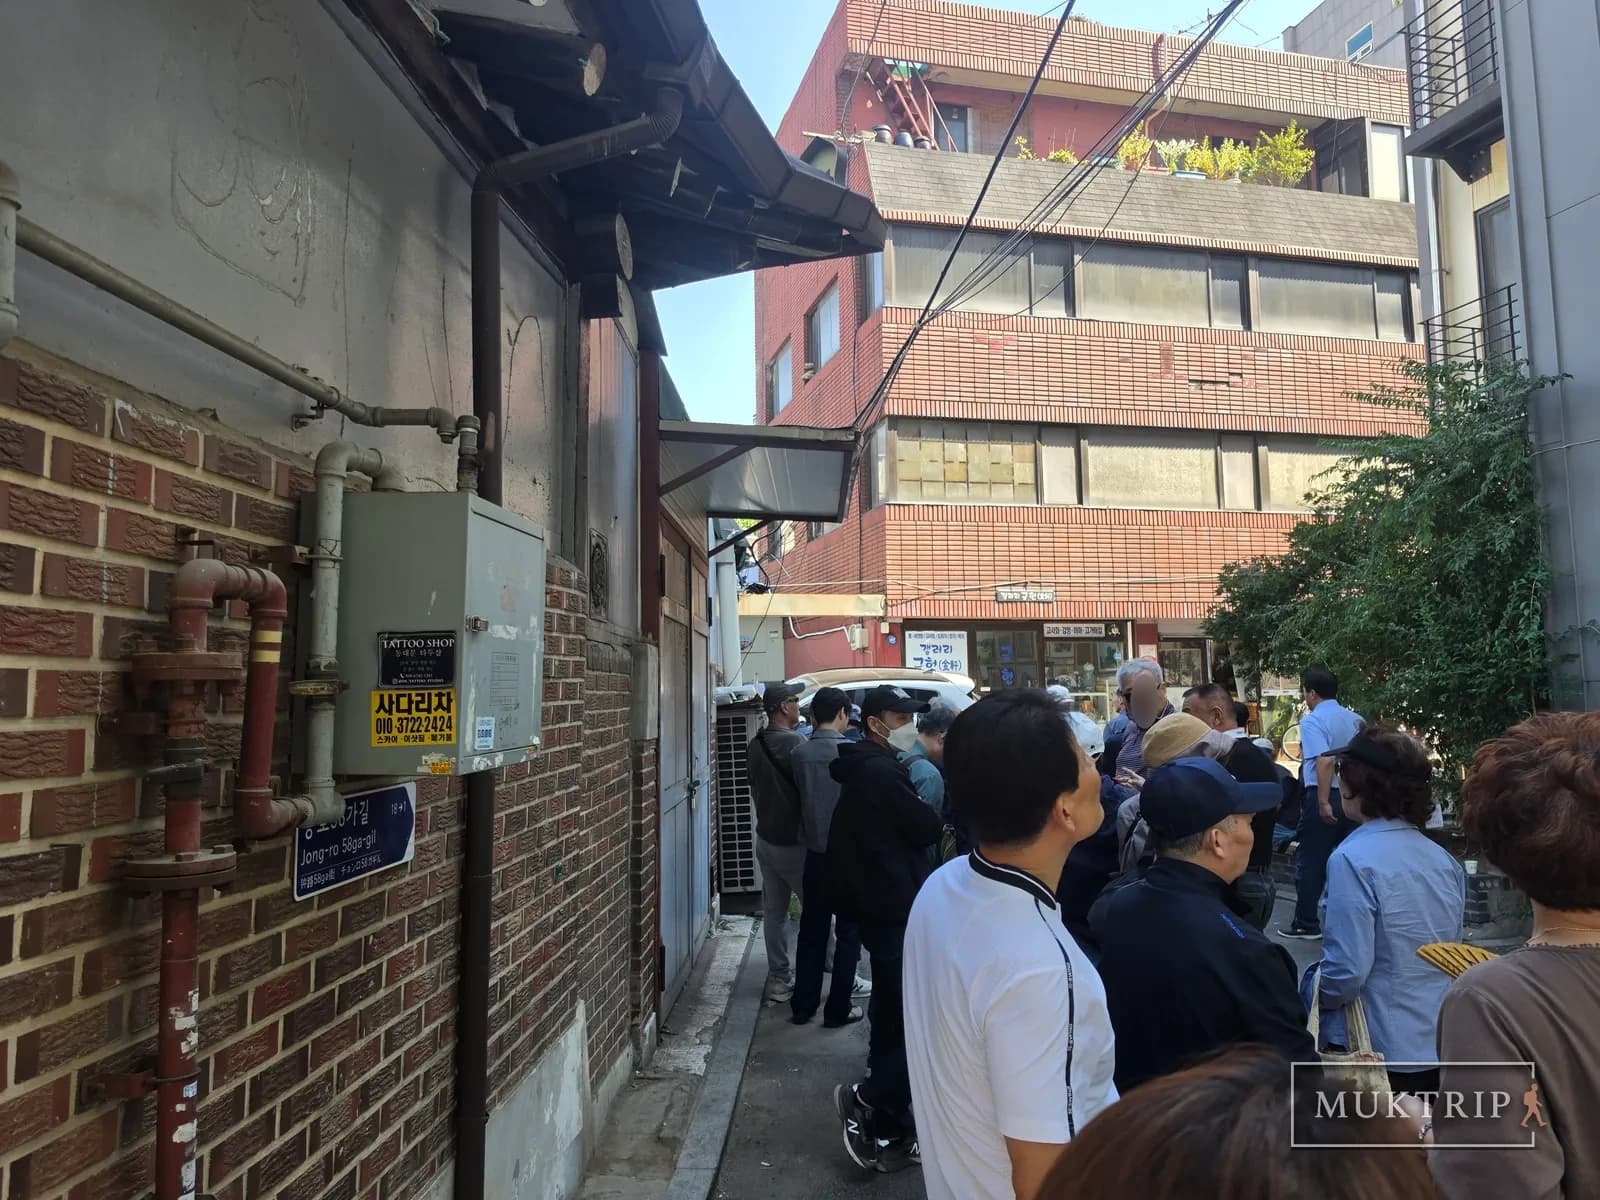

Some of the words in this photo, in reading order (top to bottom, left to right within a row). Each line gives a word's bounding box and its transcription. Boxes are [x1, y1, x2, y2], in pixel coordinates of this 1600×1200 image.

[382, 638, 425, 649] TATTOO
[426, 638, 455, 648] SHOP
[919, 643, 953, 655] 갤러리
[375, 691, 454, 716] 사다리차
[376, 735, 398, 744] 스카이
[300, 843, 339, 867] Jong-ro
[341, 829, 377, 855] 58ga-gil
